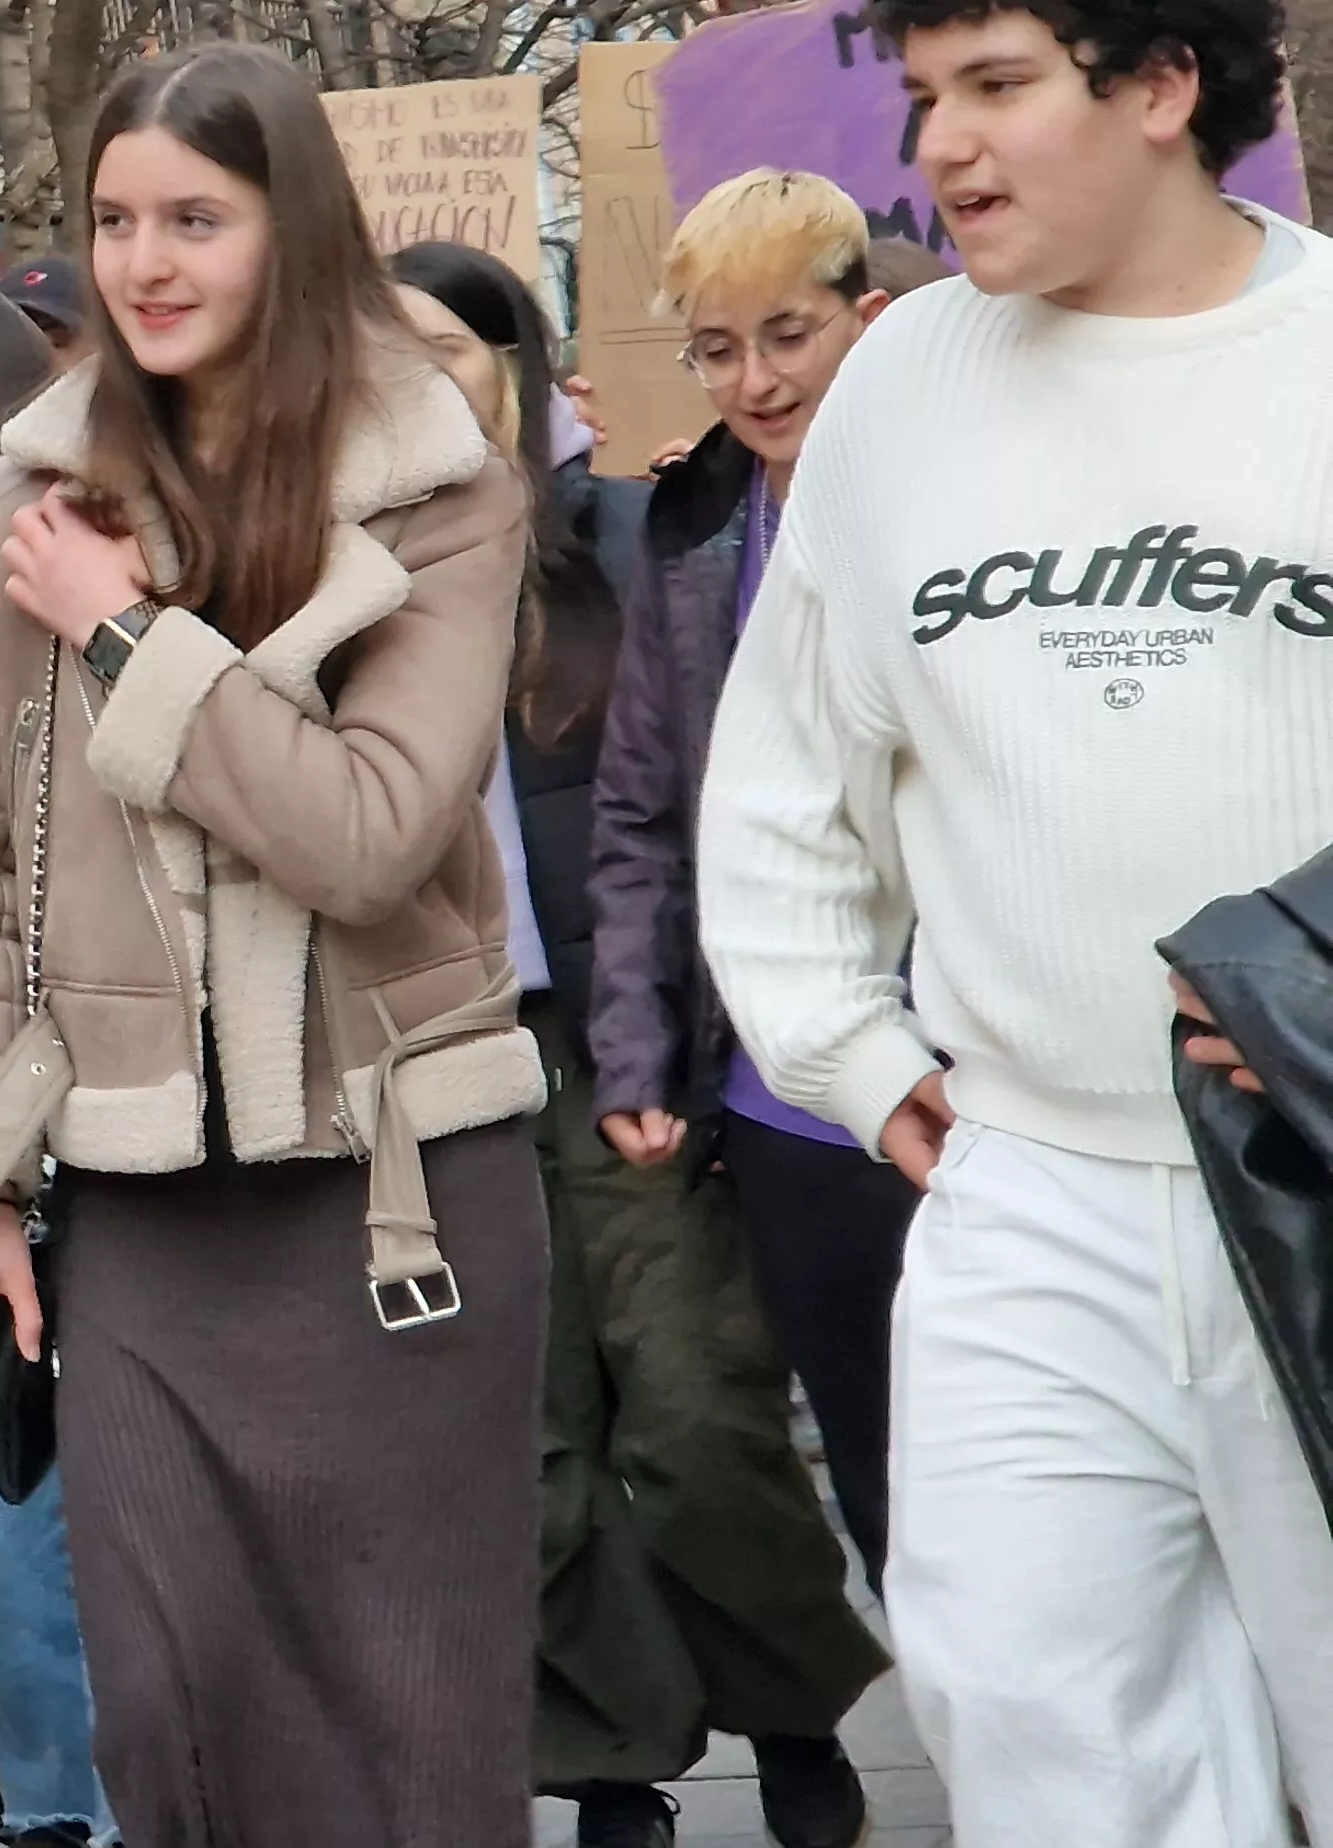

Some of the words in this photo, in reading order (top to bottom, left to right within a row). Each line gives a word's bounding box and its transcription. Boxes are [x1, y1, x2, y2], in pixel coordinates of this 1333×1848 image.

[1039, 630, 1139, 649] EVERYDAY
[1145, 627, 1214, 647] URBAN
[1065, 649, 1188, 670] AESTHETICS
